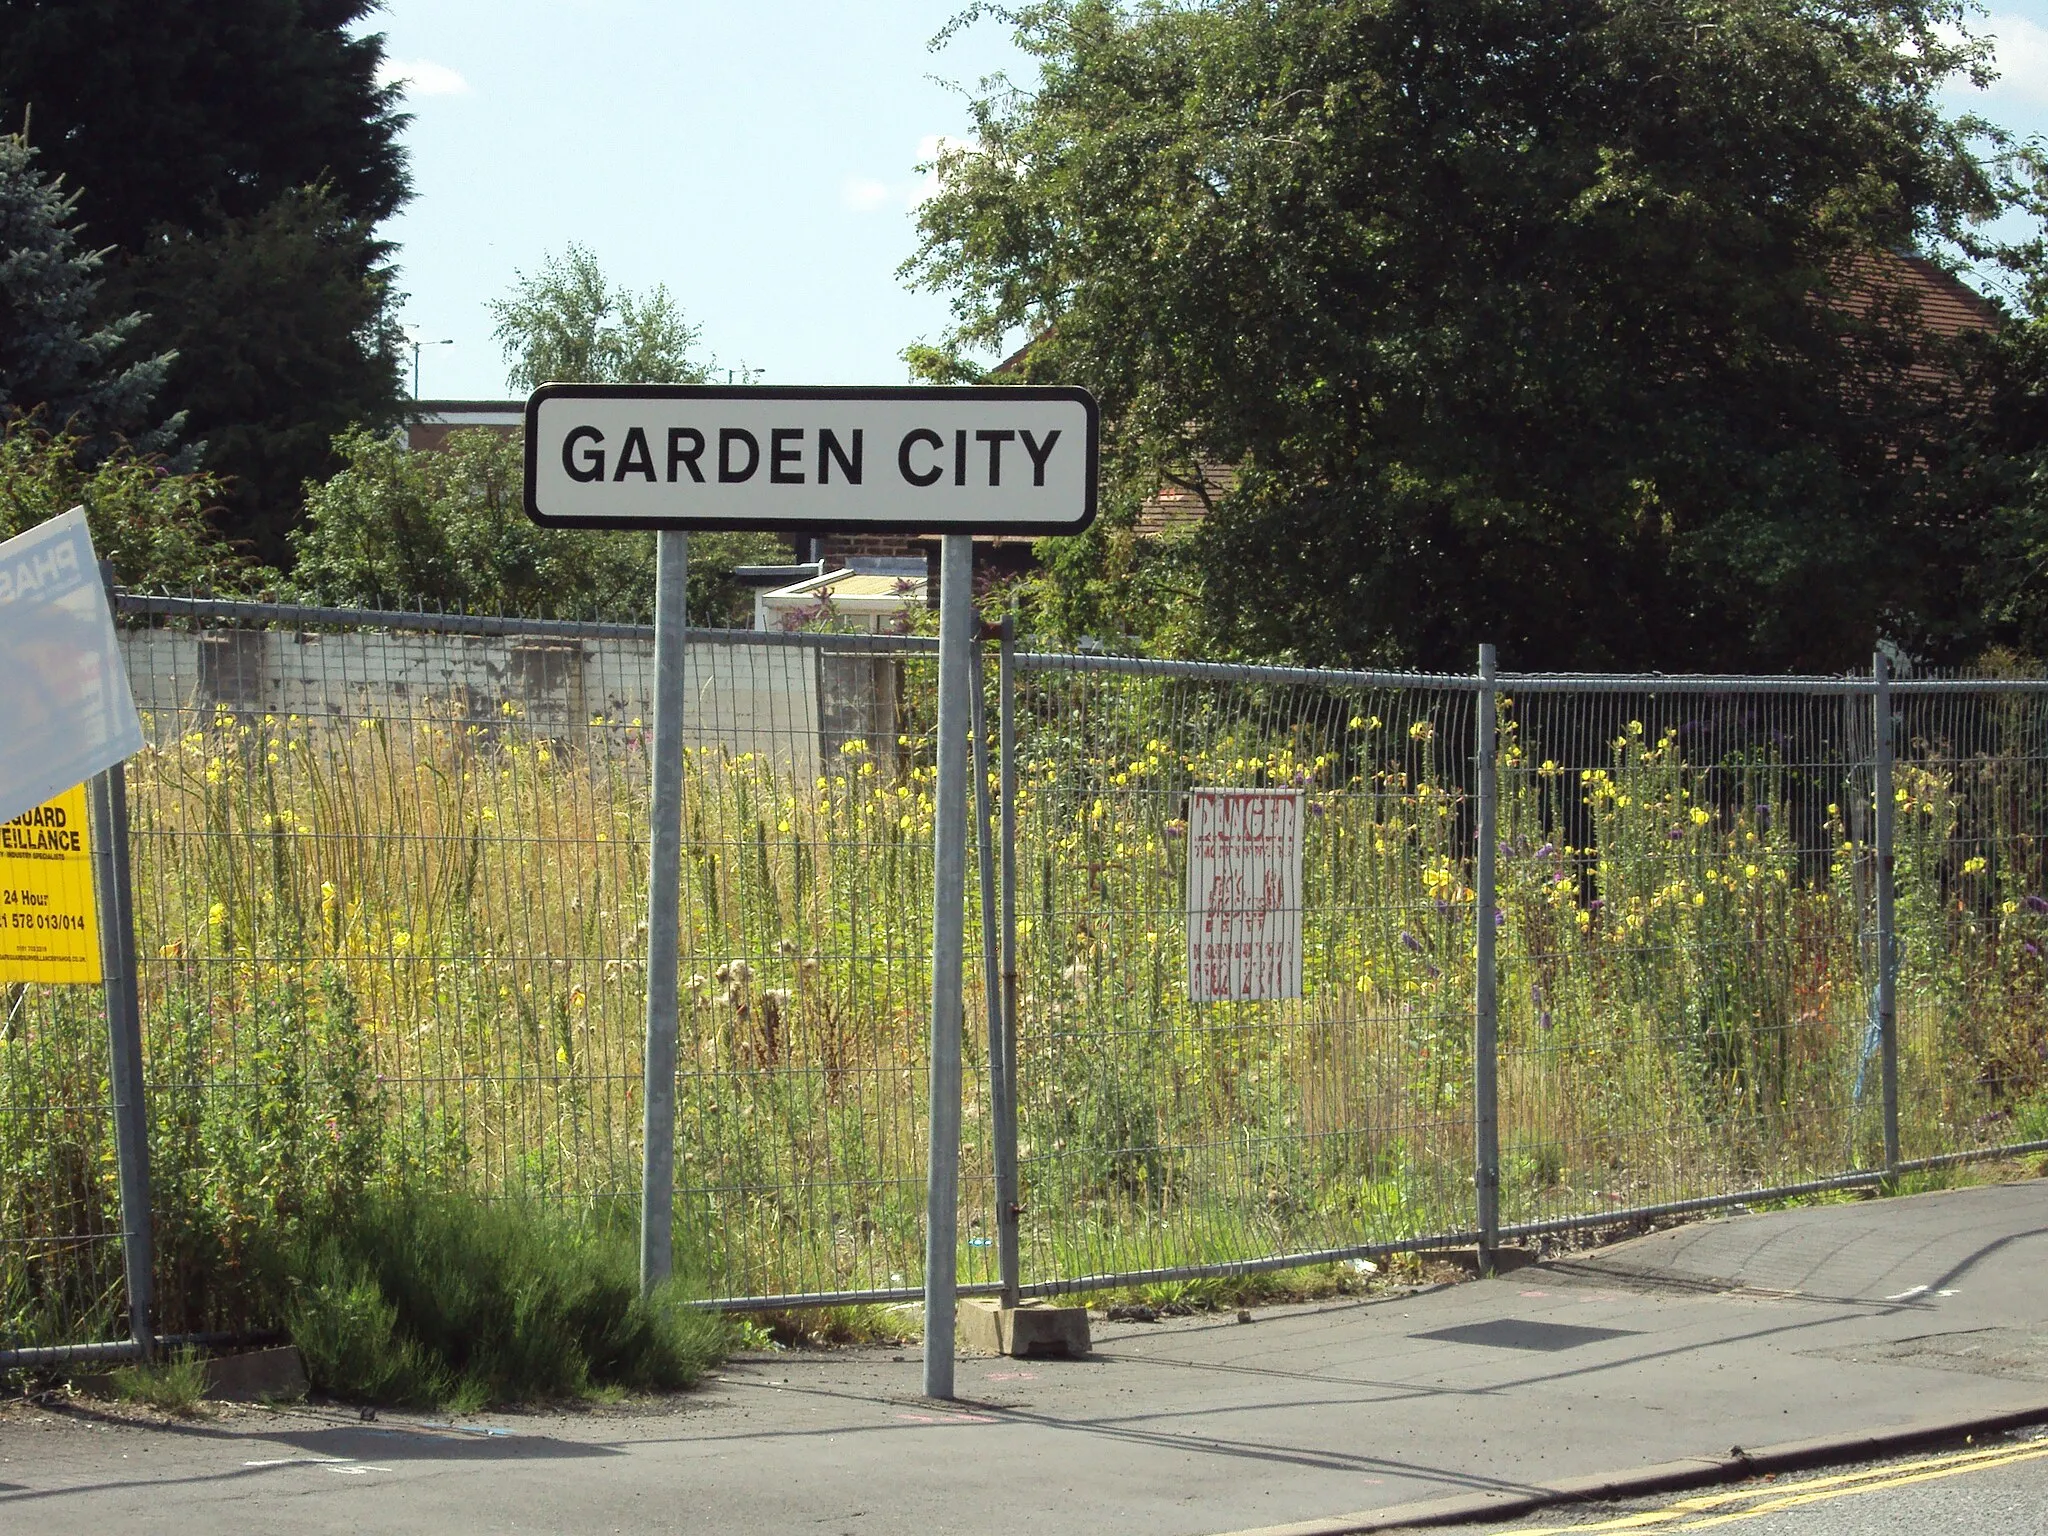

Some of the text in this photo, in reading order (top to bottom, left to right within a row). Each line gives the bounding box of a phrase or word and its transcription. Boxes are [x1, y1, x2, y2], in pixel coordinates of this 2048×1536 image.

[561, 425, 1062, 487] GARDEN CITY
[4, 806, 66, 828] GUARD
[2, 828, 81, 851] EILLANCE
[3, 889, 48, 906] 24 Hour
[12, 913, 34, 929] 578
[37, 914, 85, 930] 013/014
